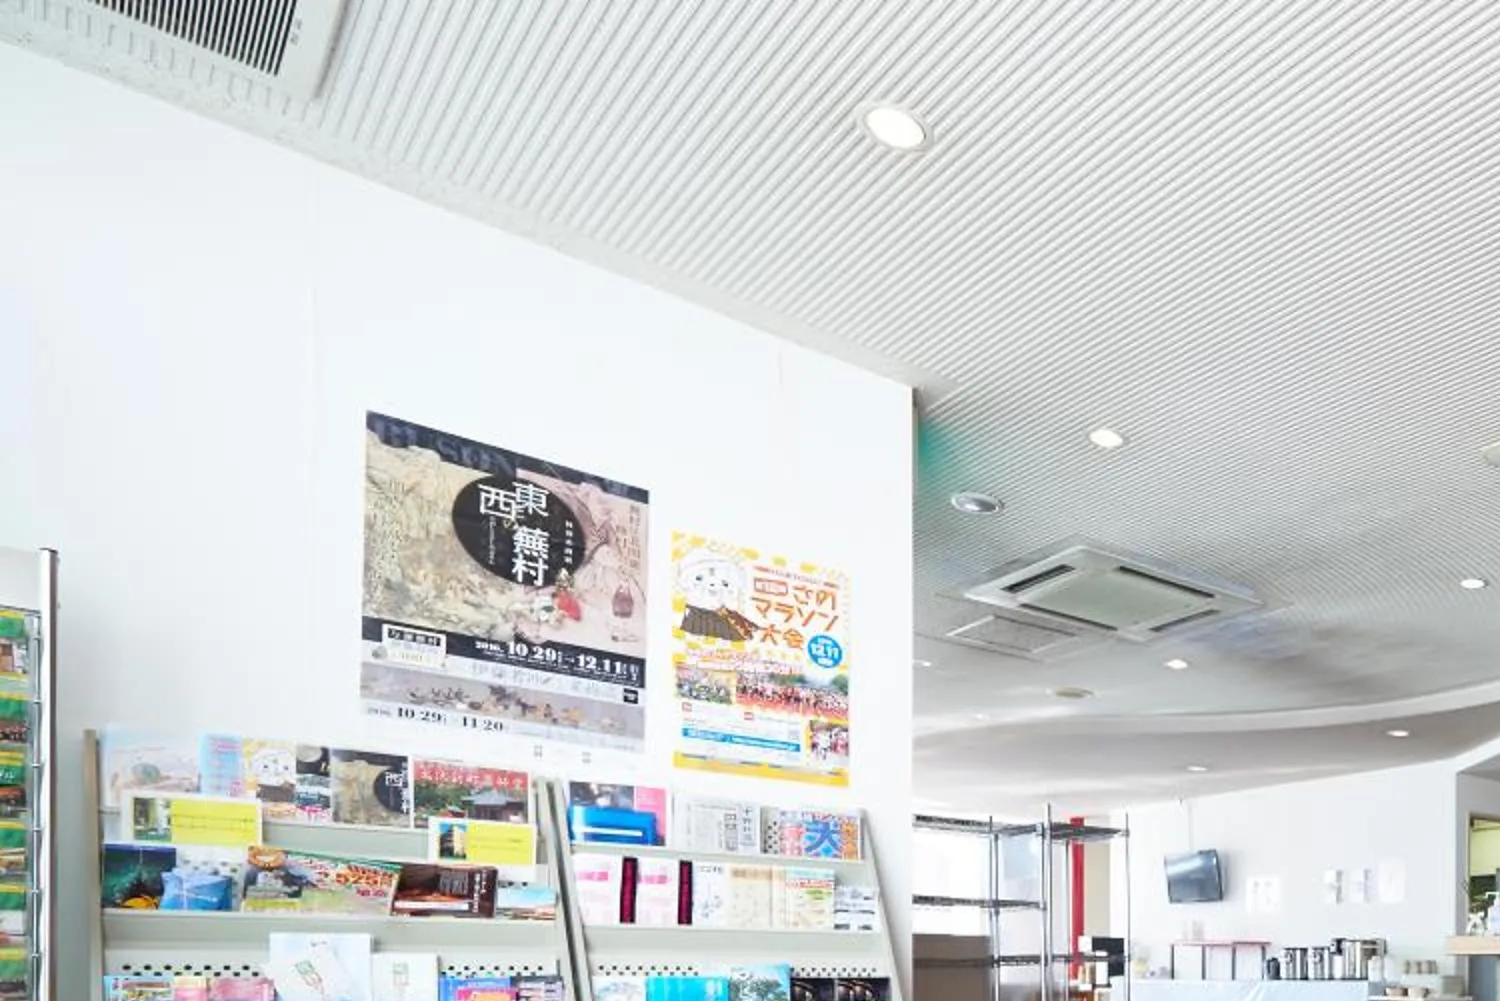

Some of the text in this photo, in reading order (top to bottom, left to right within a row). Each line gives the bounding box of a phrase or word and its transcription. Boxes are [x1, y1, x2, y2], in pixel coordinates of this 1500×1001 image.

[751, 596, 839, 633] マラソン
[759, 623, 804, 650] 大会
